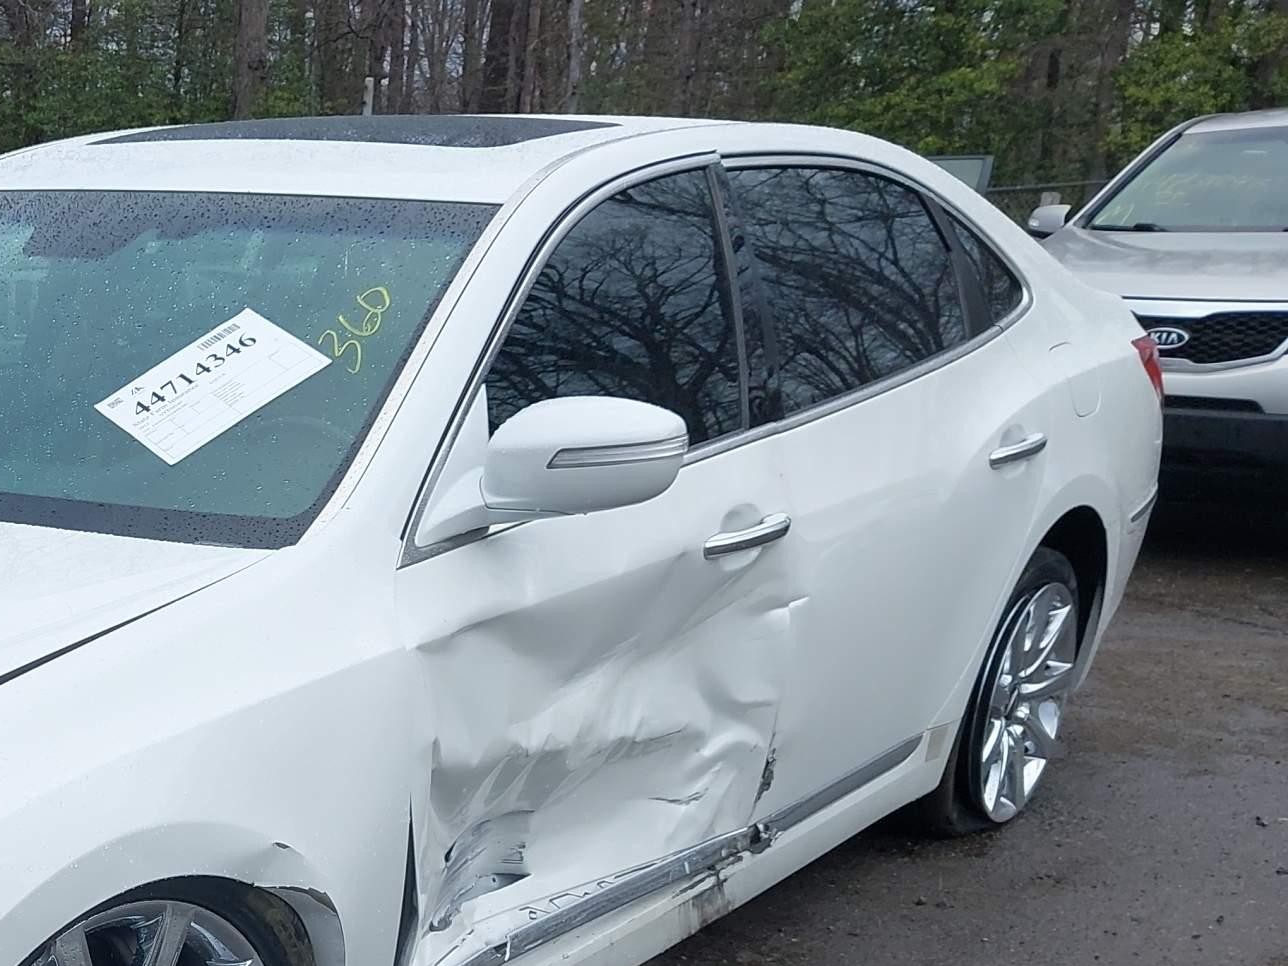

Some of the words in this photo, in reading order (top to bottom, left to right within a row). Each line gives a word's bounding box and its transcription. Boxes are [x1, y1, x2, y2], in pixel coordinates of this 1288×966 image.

[318, 286, 391, 374] 360
[1150, 332, 1178, 344] KIA
[135, 332, 257, 415] 44714346
